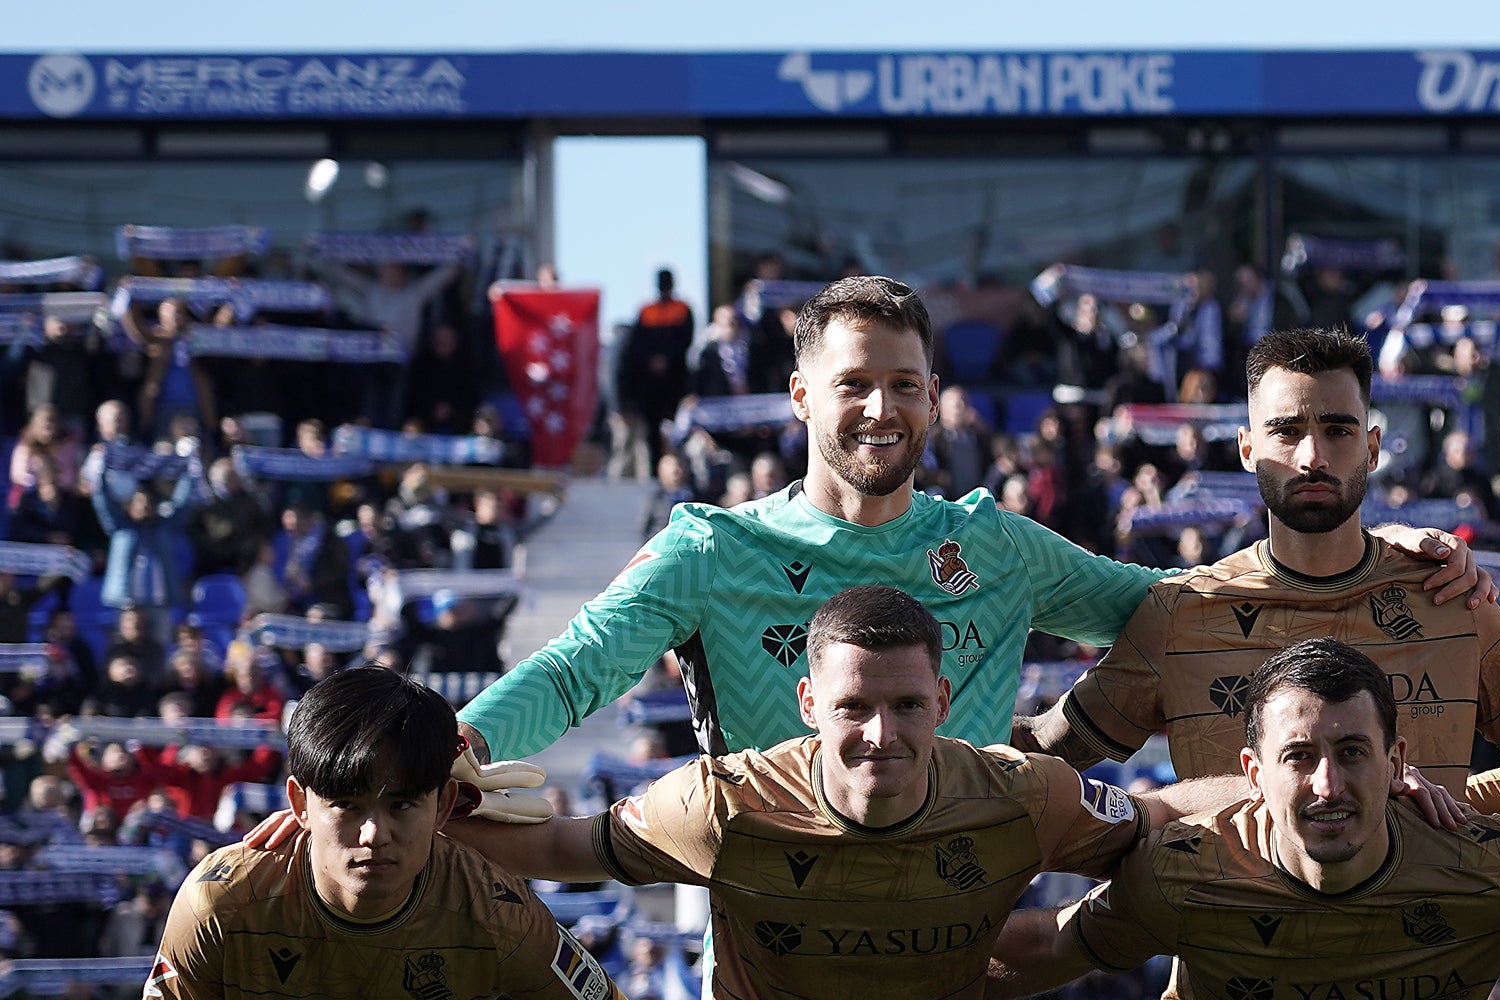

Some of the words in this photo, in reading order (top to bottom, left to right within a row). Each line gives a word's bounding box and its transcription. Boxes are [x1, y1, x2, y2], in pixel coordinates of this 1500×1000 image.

[878, 53, 1042, 114] URBAN
[1048, 53, 1176, 114] POKE
[1410, 705, 1445, 718] group
[819, 913, 994, 955] YASUDA
